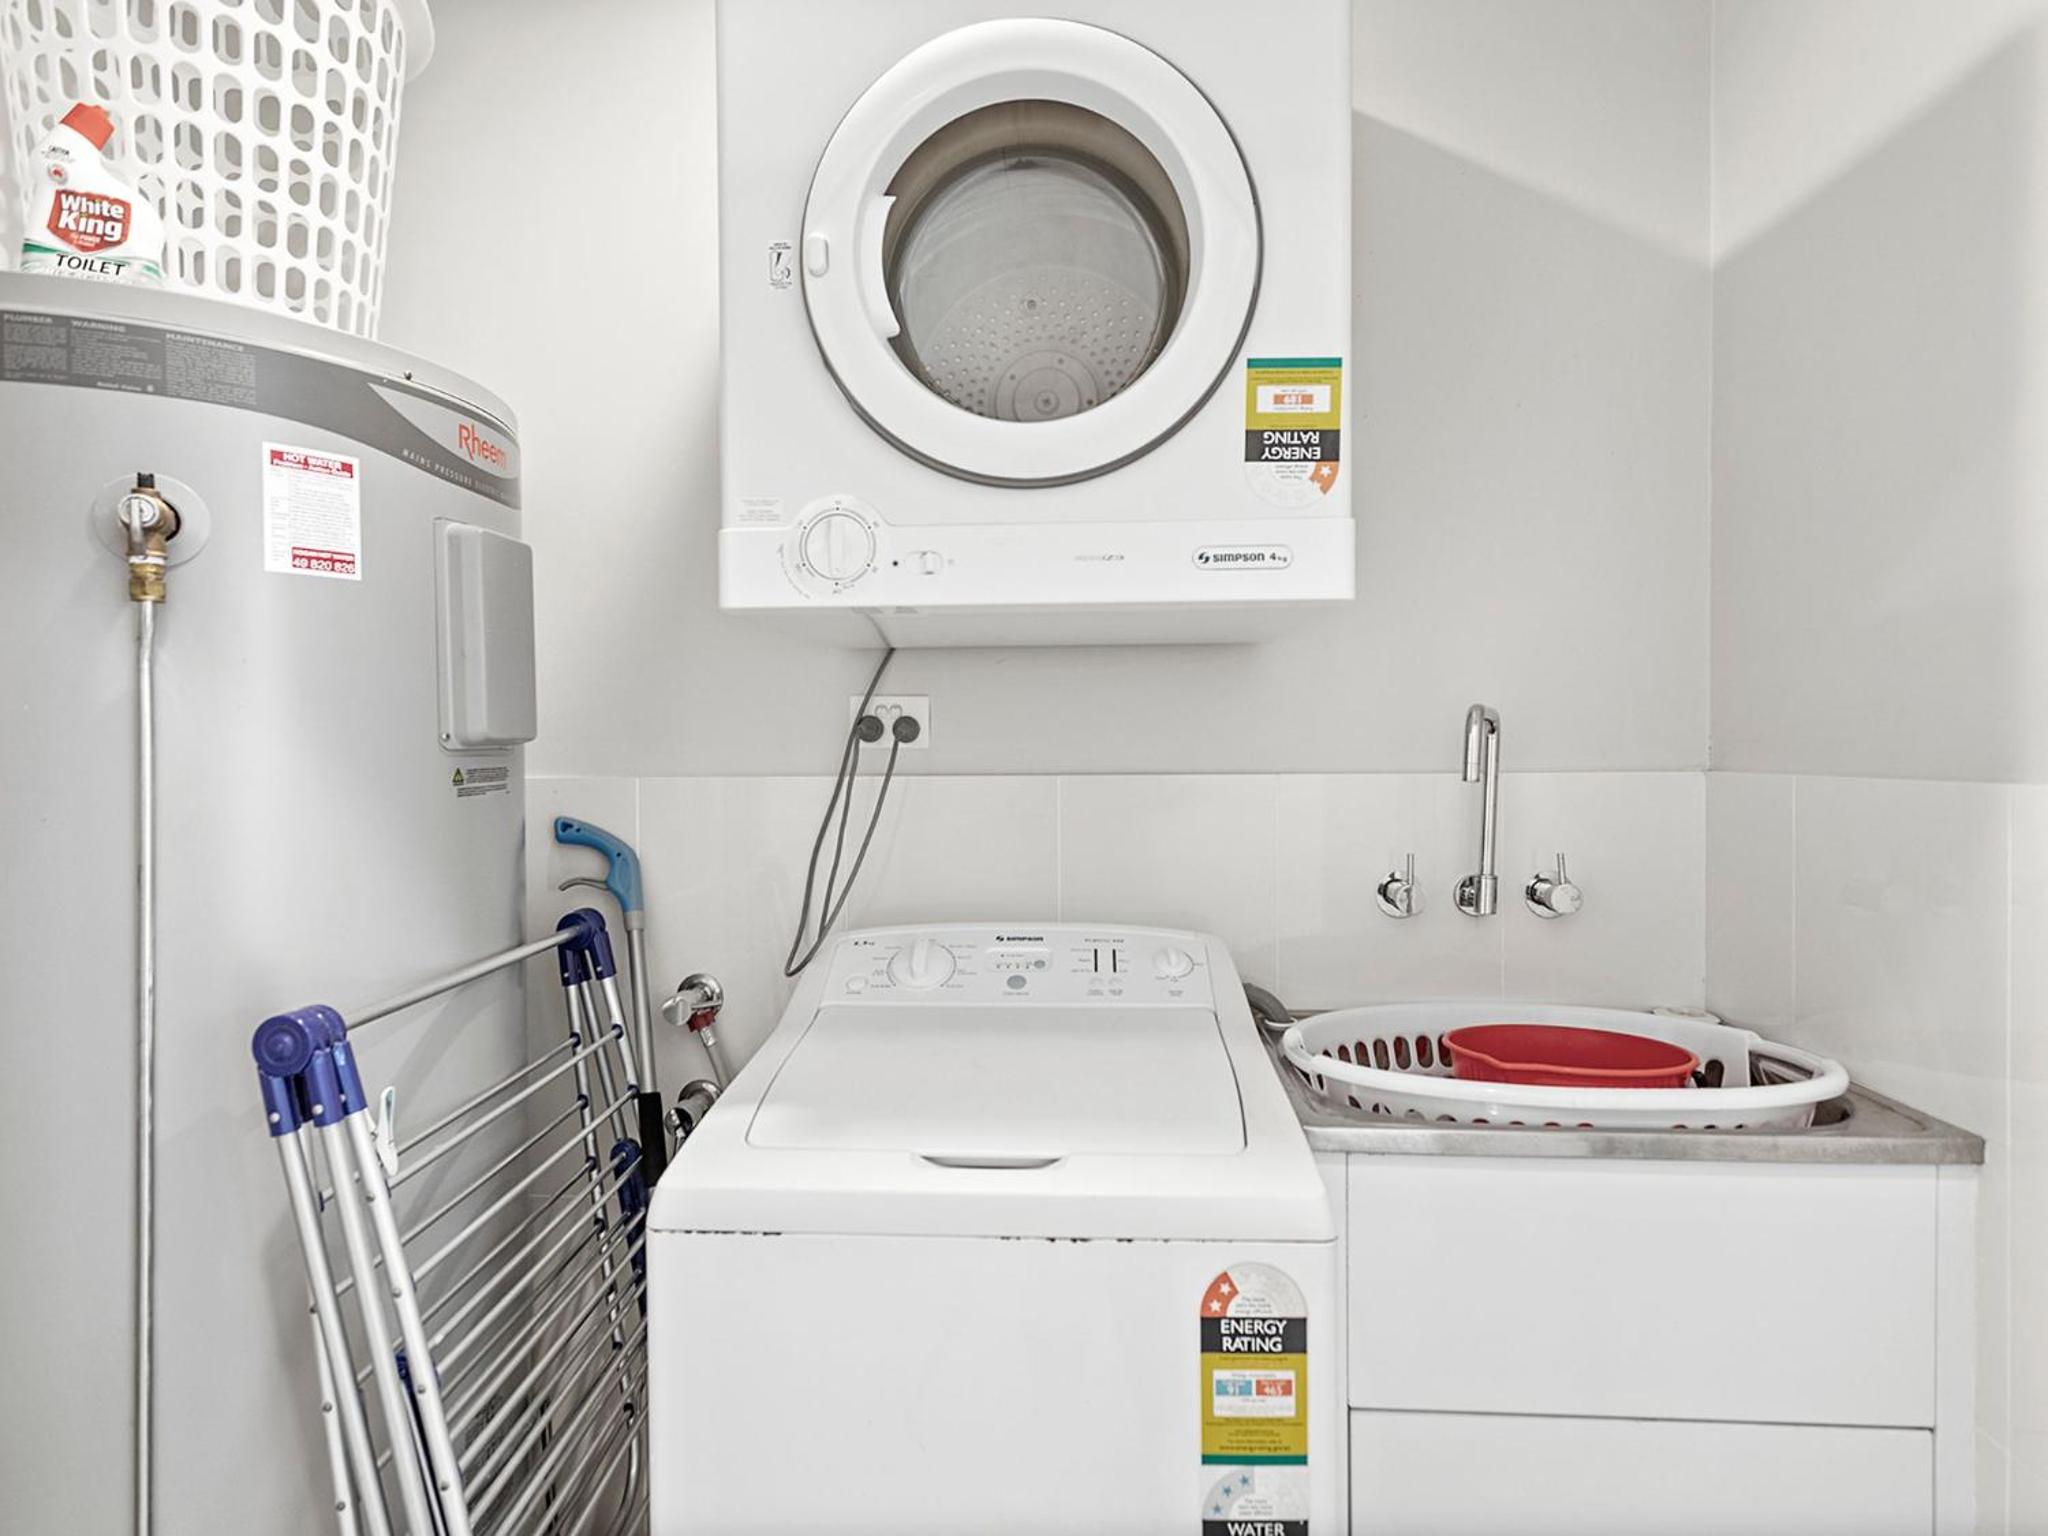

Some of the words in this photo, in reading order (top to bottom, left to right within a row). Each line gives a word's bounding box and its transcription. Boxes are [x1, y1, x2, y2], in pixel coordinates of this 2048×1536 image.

[60, 194, 124, 218] White
[57, 211, 123, 242] King
[57, 254, 126, 276] TOILET
[72, 320, 127, 333] WARNING
[166, 333, 244, 351] MAINTENANCE
[1263, 431, 1320, 444] RATING
[458, 423, 508, 469] Rheem
[1261, 447, 1322, 459] ENERGY
[284, 452, 303, 464] HOT
[1213, 552, 1264, 563] SIMPSON
[1220, 1319, 1287, 1335] ENERGY
[1222, 1337, 1282, 1352] RATING
[1227, 1522, 1286, 1536] WATER
